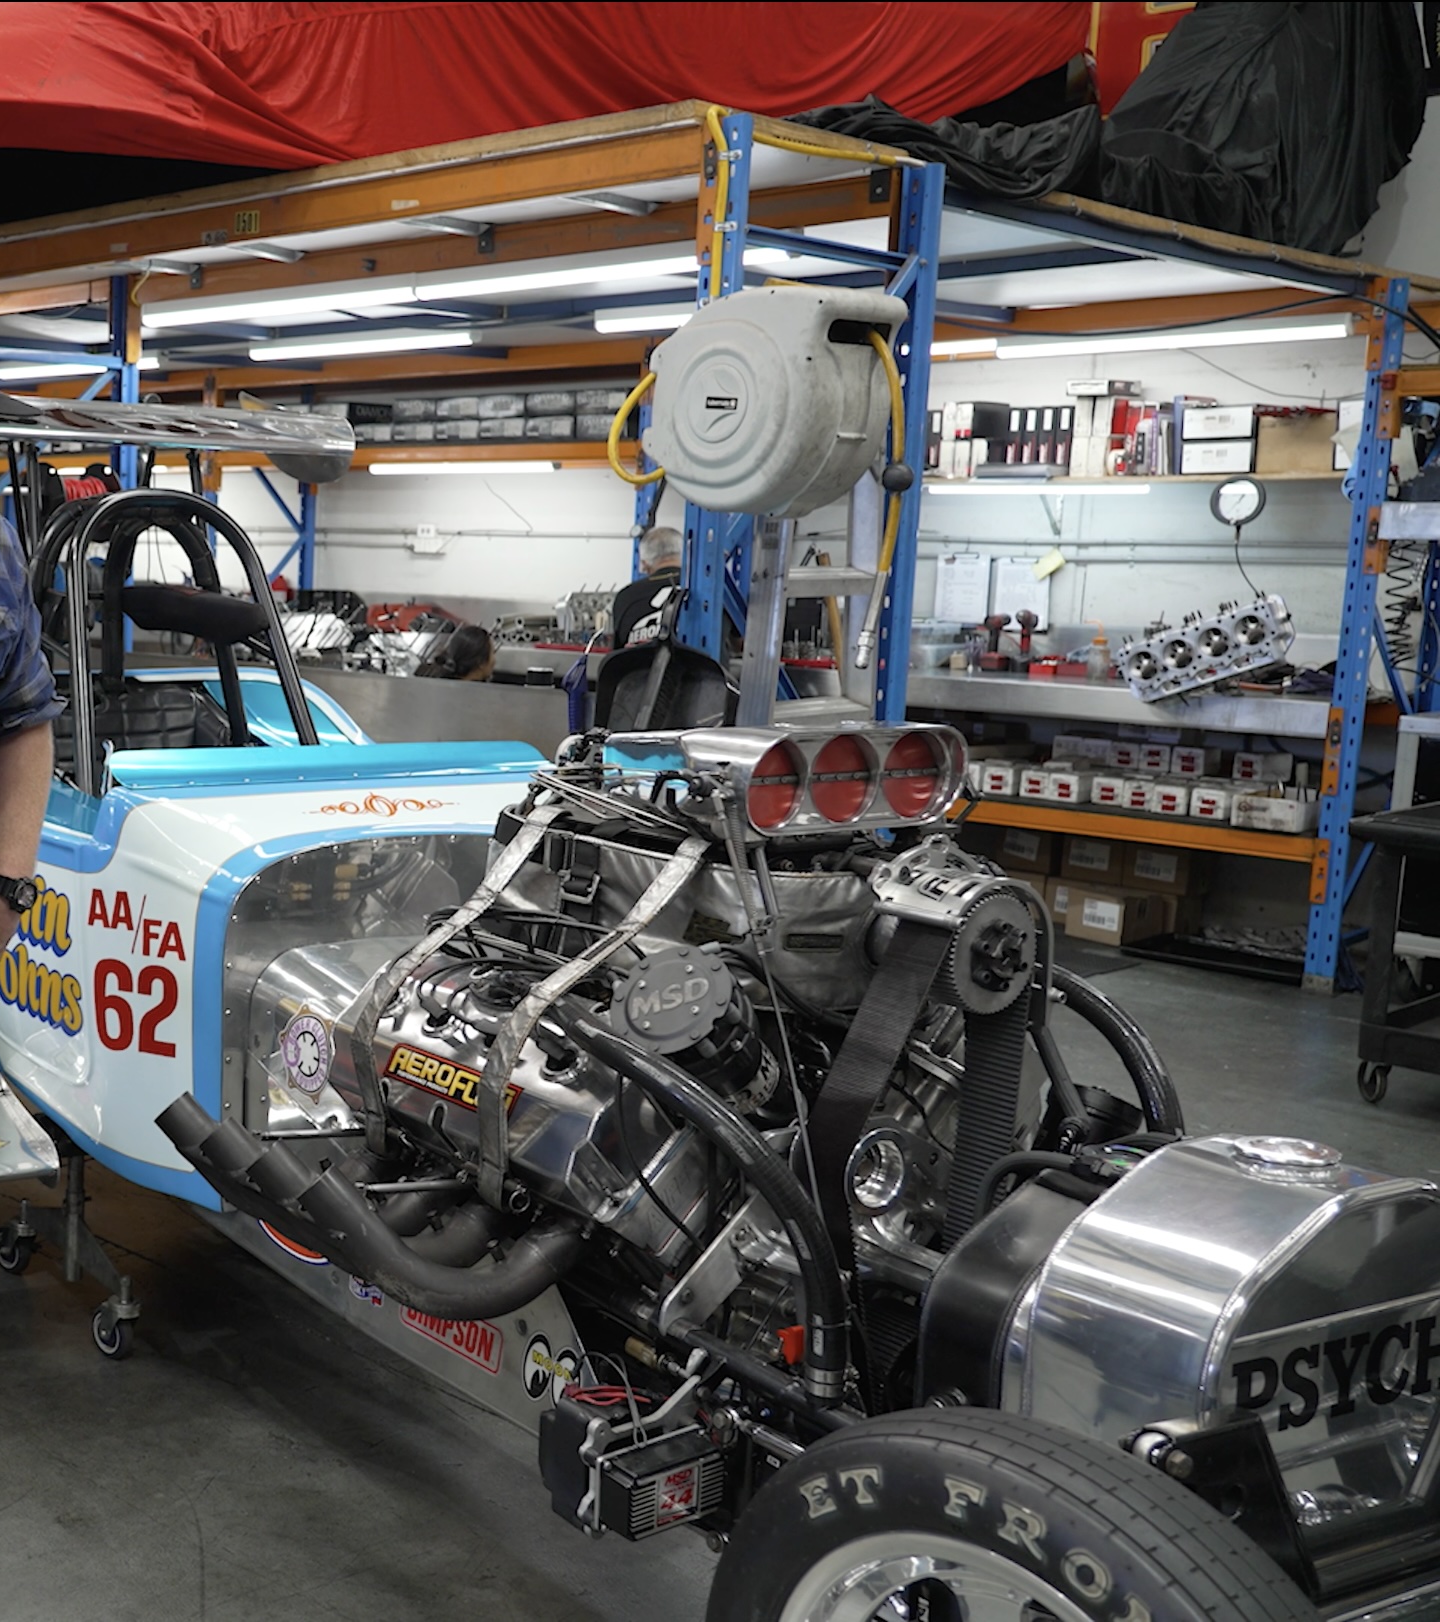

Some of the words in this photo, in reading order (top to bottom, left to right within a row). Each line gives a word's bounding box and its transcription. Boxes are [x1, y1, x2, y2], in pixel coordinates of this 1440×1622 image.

[88, 888, 186, 961] AA/FA
[94, 958, 178, 1058] 62
[631, 977, 710, 1020] MSD
[664, 1468, 693, 1487] MSD
[798, 1466, 882, 1520] ET
